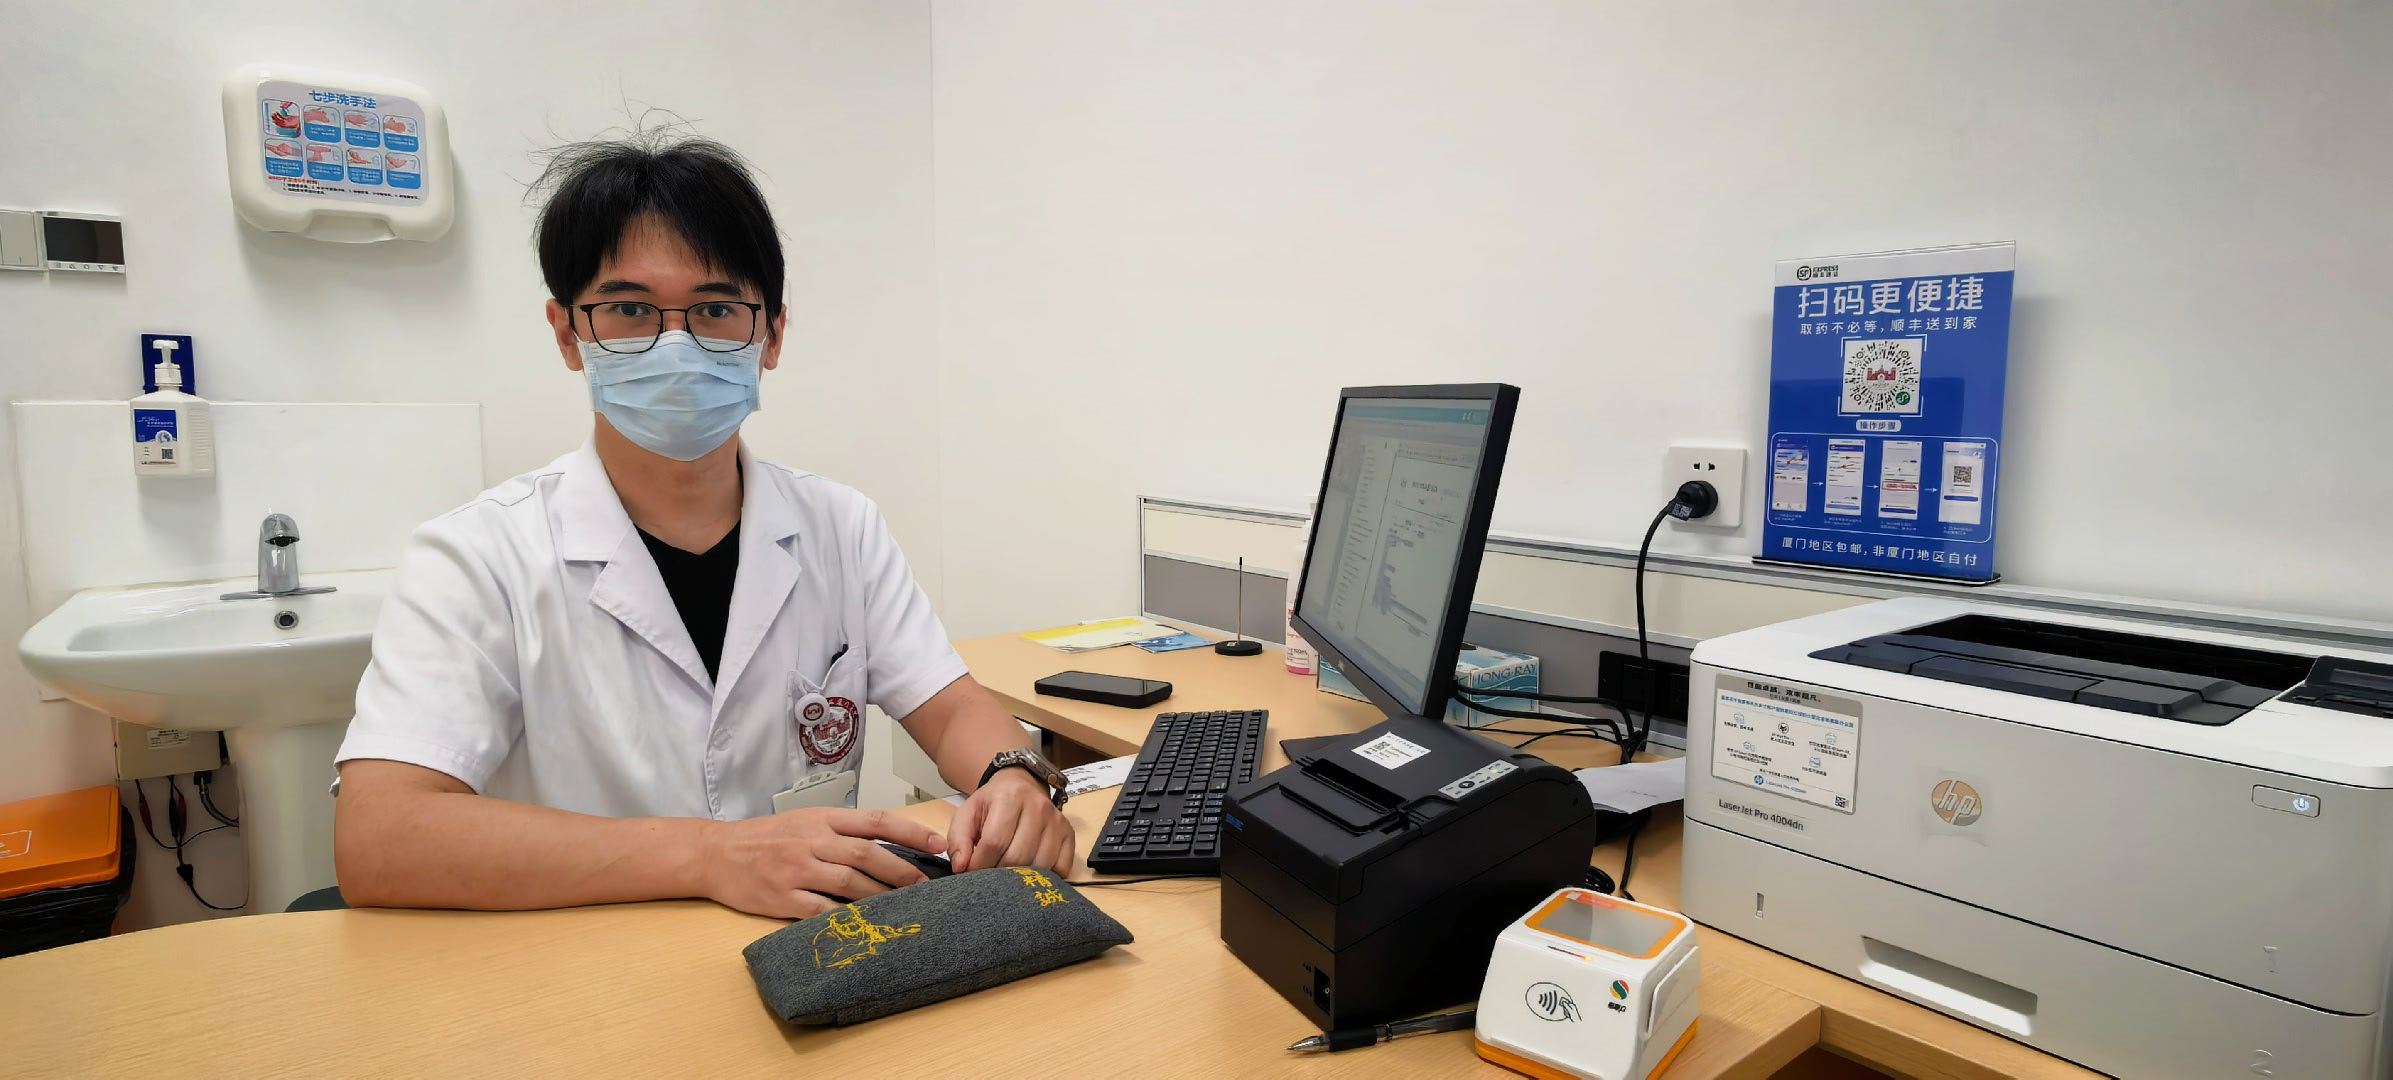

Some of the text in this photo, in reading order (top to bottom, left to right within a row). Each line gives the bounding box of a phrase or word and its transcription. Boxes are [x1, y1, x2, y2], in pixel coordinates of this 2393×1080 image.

[309, 90, 377, 109] 七步洗手法
[1798, 277, 1984, 319] 扫码更便捷
[1800, 316, 1978, 335] 取药不必等，顺丰送到家
[1782, 537, 1977, 566] 厦门地区包邮，非厦门地区自付
[1718, 799, 1804, 831] LaserJet Pro 4004dn
[1935, 780, 1978, 826] hp
